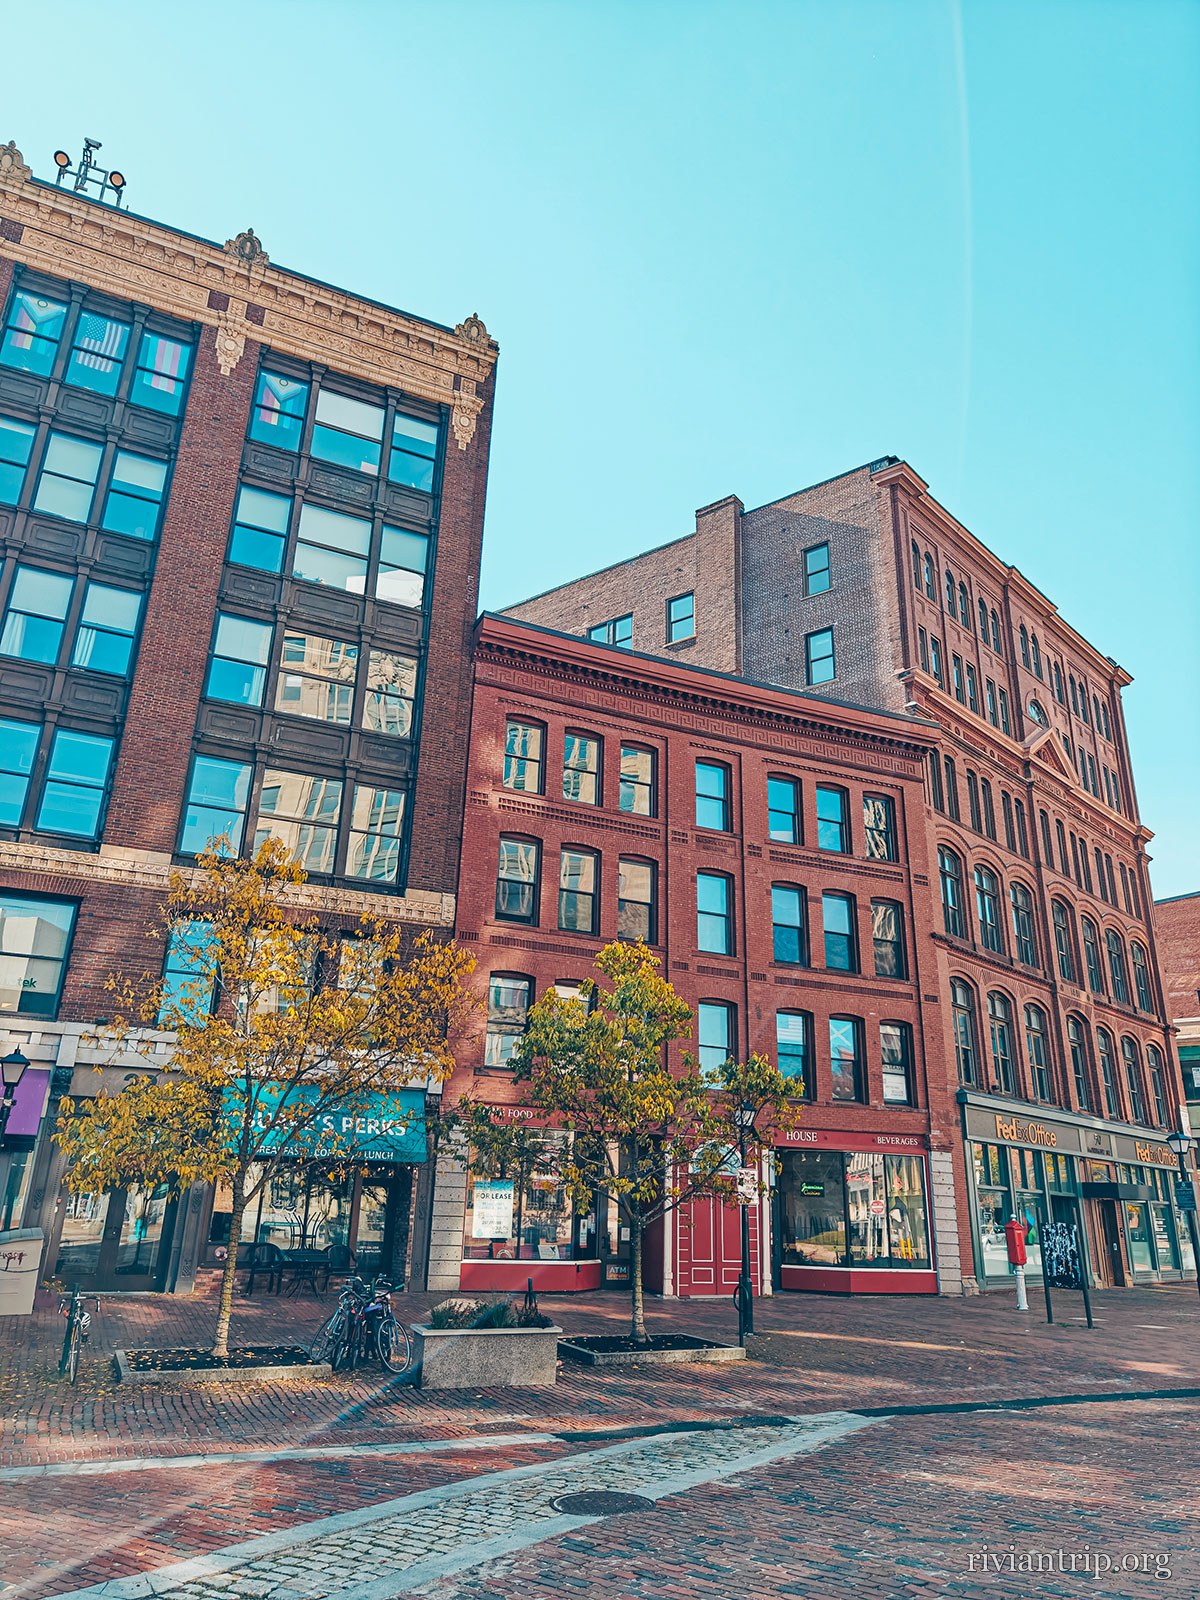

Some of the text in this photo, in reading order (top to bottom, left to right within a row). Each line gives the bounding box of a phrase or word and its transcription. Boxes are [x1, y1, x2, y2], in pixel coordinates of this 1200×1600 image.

[508, 1109, 533, 1119] FOOD
[247, 1110, 406, 1136] UE'S PERKS
[994, 1114, 1057, 1147] FedEx Office
[786, 1131, 818, 1142] HOUSE
[877, 1136, 919, 1146] BEVERAGES
[253, 1145, 304, 1156] REAFAS
[364, 1150, 394, 1160] LUNCH
[476, 1192, 512, 1200] FOR LEASE
[609, 1266, 627, 1274] ATM
